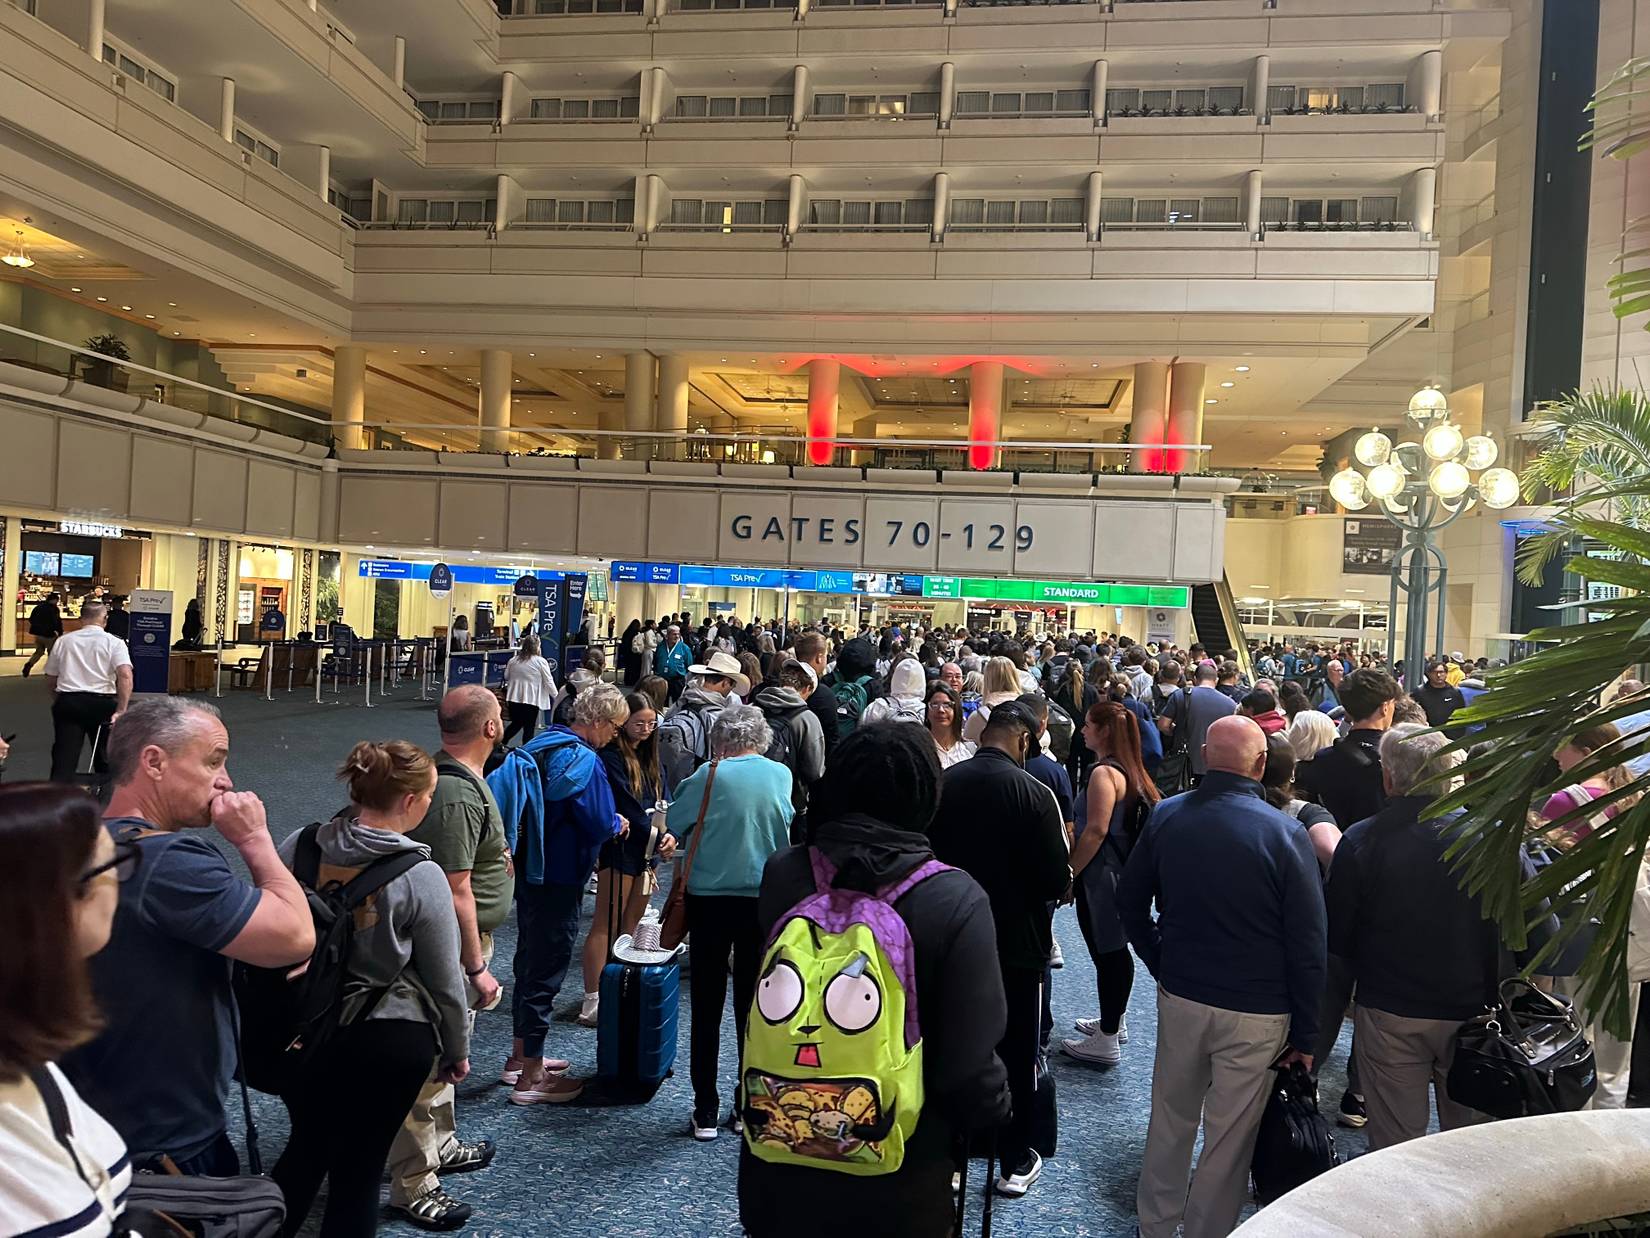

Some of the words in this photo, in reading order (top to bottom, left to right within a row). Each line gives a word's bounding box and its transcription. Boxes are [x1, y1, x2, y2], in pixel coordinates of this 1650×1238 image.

[61, 522, 122, 538] STARBUCKS
[731, 515, 860, 544] GATES
[886, 520, 1034, 552] 70-129
[544, 584, 558, 608] TSA
[1043, 586, 1099, 598] STANDARD
[543, 610, 556, 631] Pre
